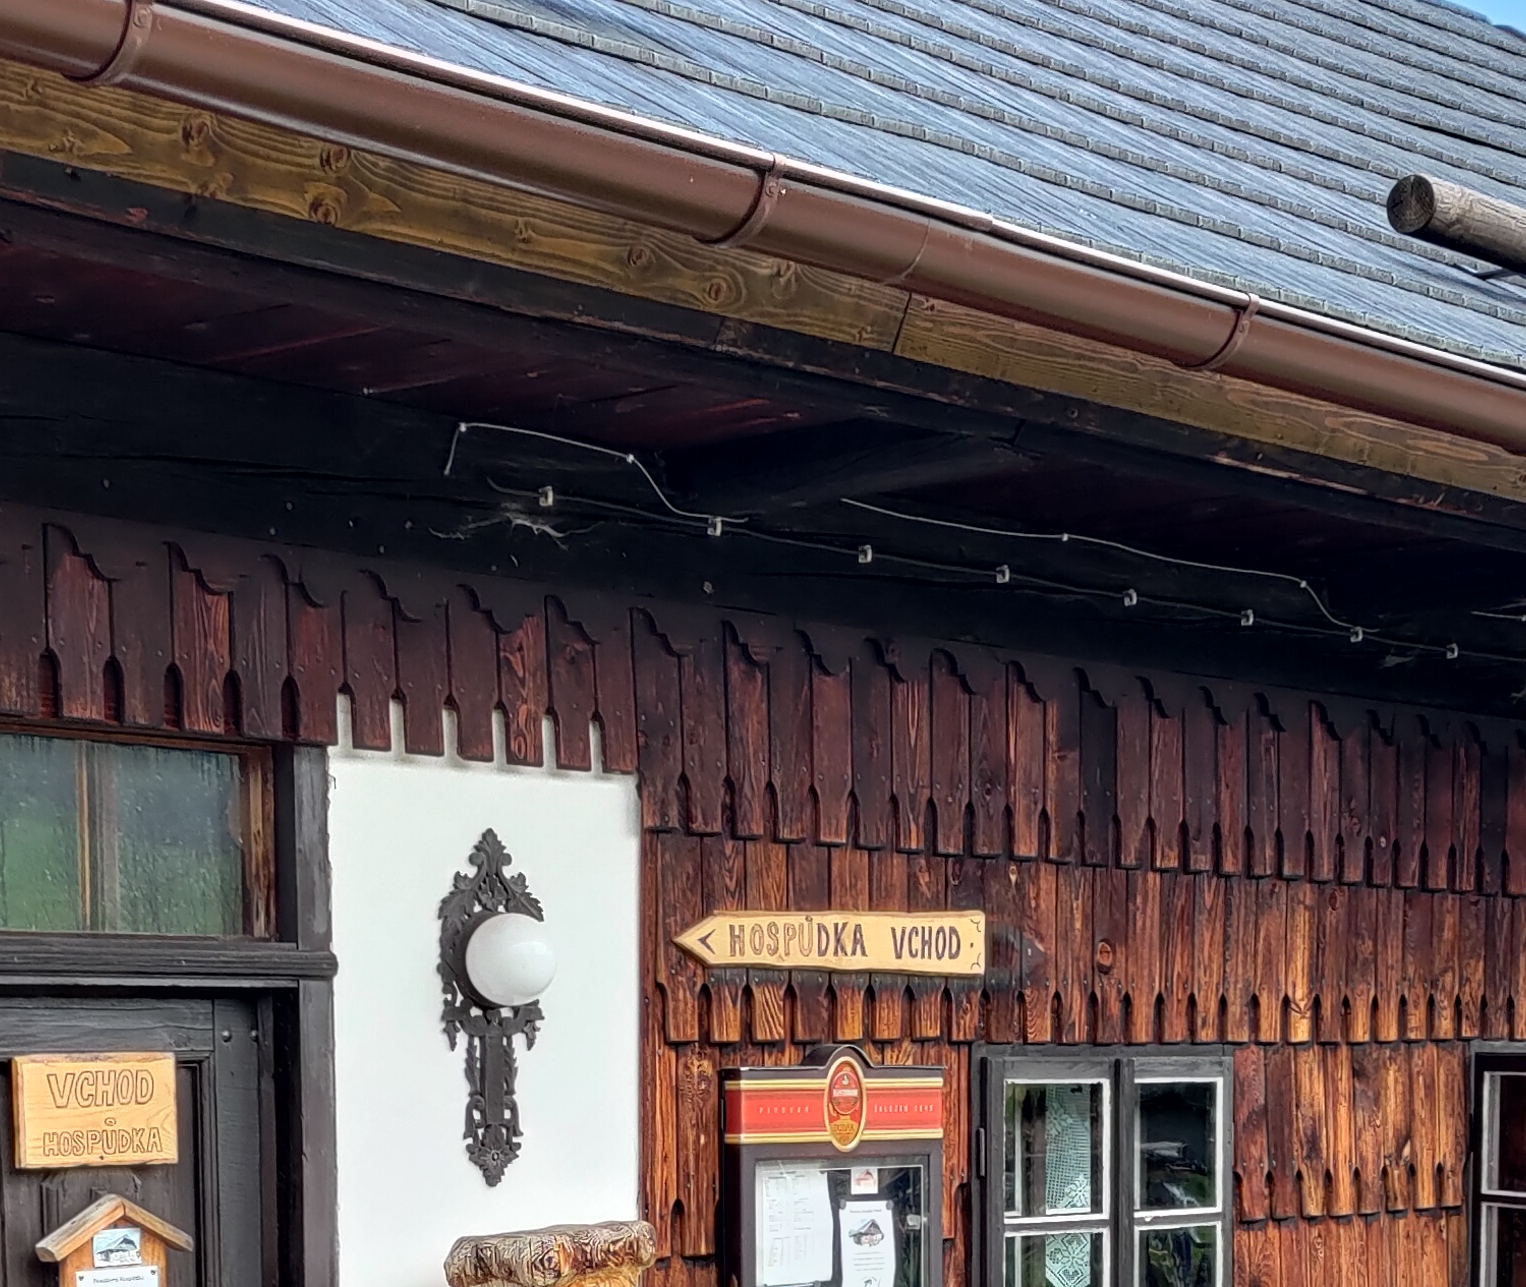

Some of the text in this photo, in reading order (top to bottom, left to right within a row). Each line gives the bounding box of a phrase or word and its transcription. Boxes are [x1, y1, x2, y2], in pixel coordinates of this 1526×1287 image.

[728, 915, 962, 961] HOSPŮDKA VCHOD
[46, 1068, 155, 1109] VCHOD
[42, 1117, 163, 1157] HOSPŮDKA
